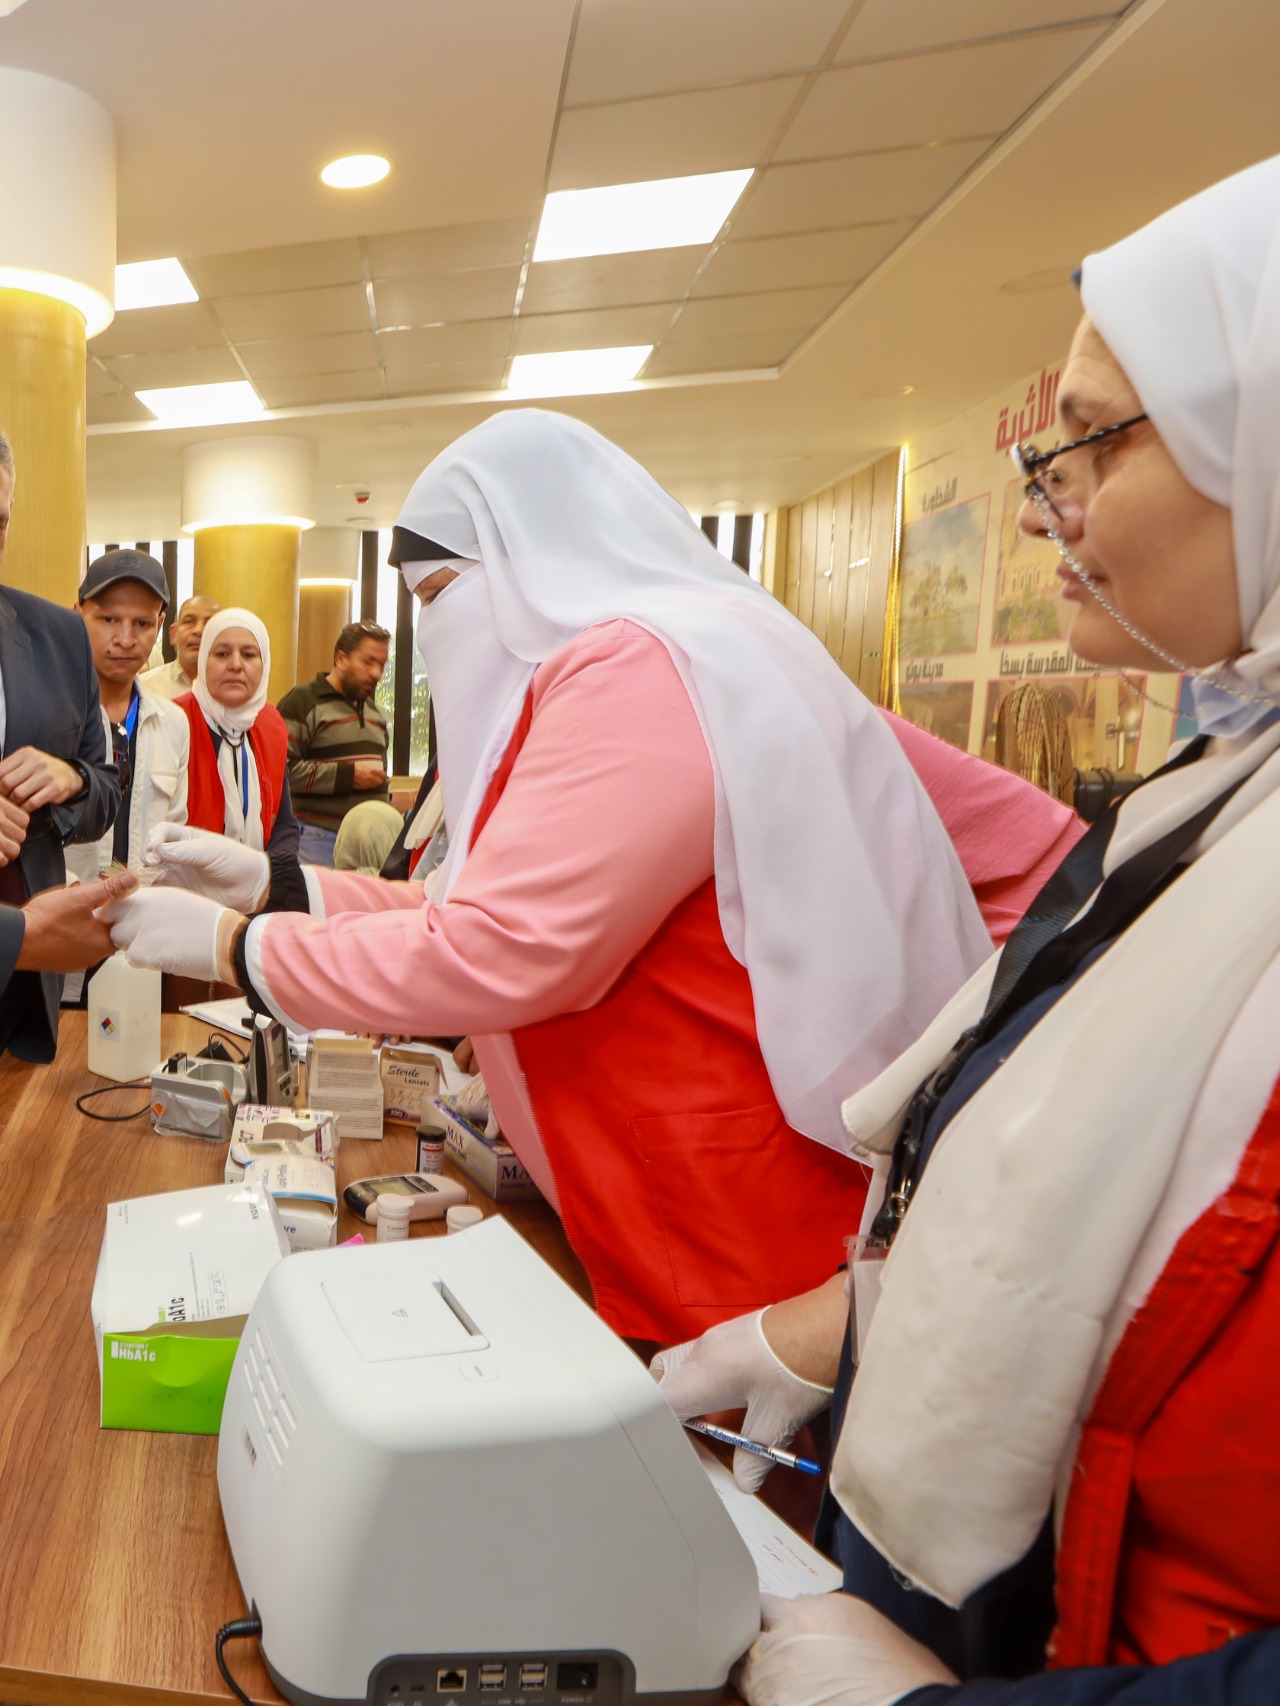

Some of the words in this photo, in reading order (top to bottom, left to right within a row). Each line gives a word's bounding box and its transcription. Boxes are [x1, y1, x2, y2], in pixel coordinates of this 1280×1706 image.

[1026, 650, 1073, 674] المقدسة
[387, 1064, 420, 1078] Sterile
[445, 1125, 464, 1150] MAX
[119, 1348, 157, 1362] HbA1c
